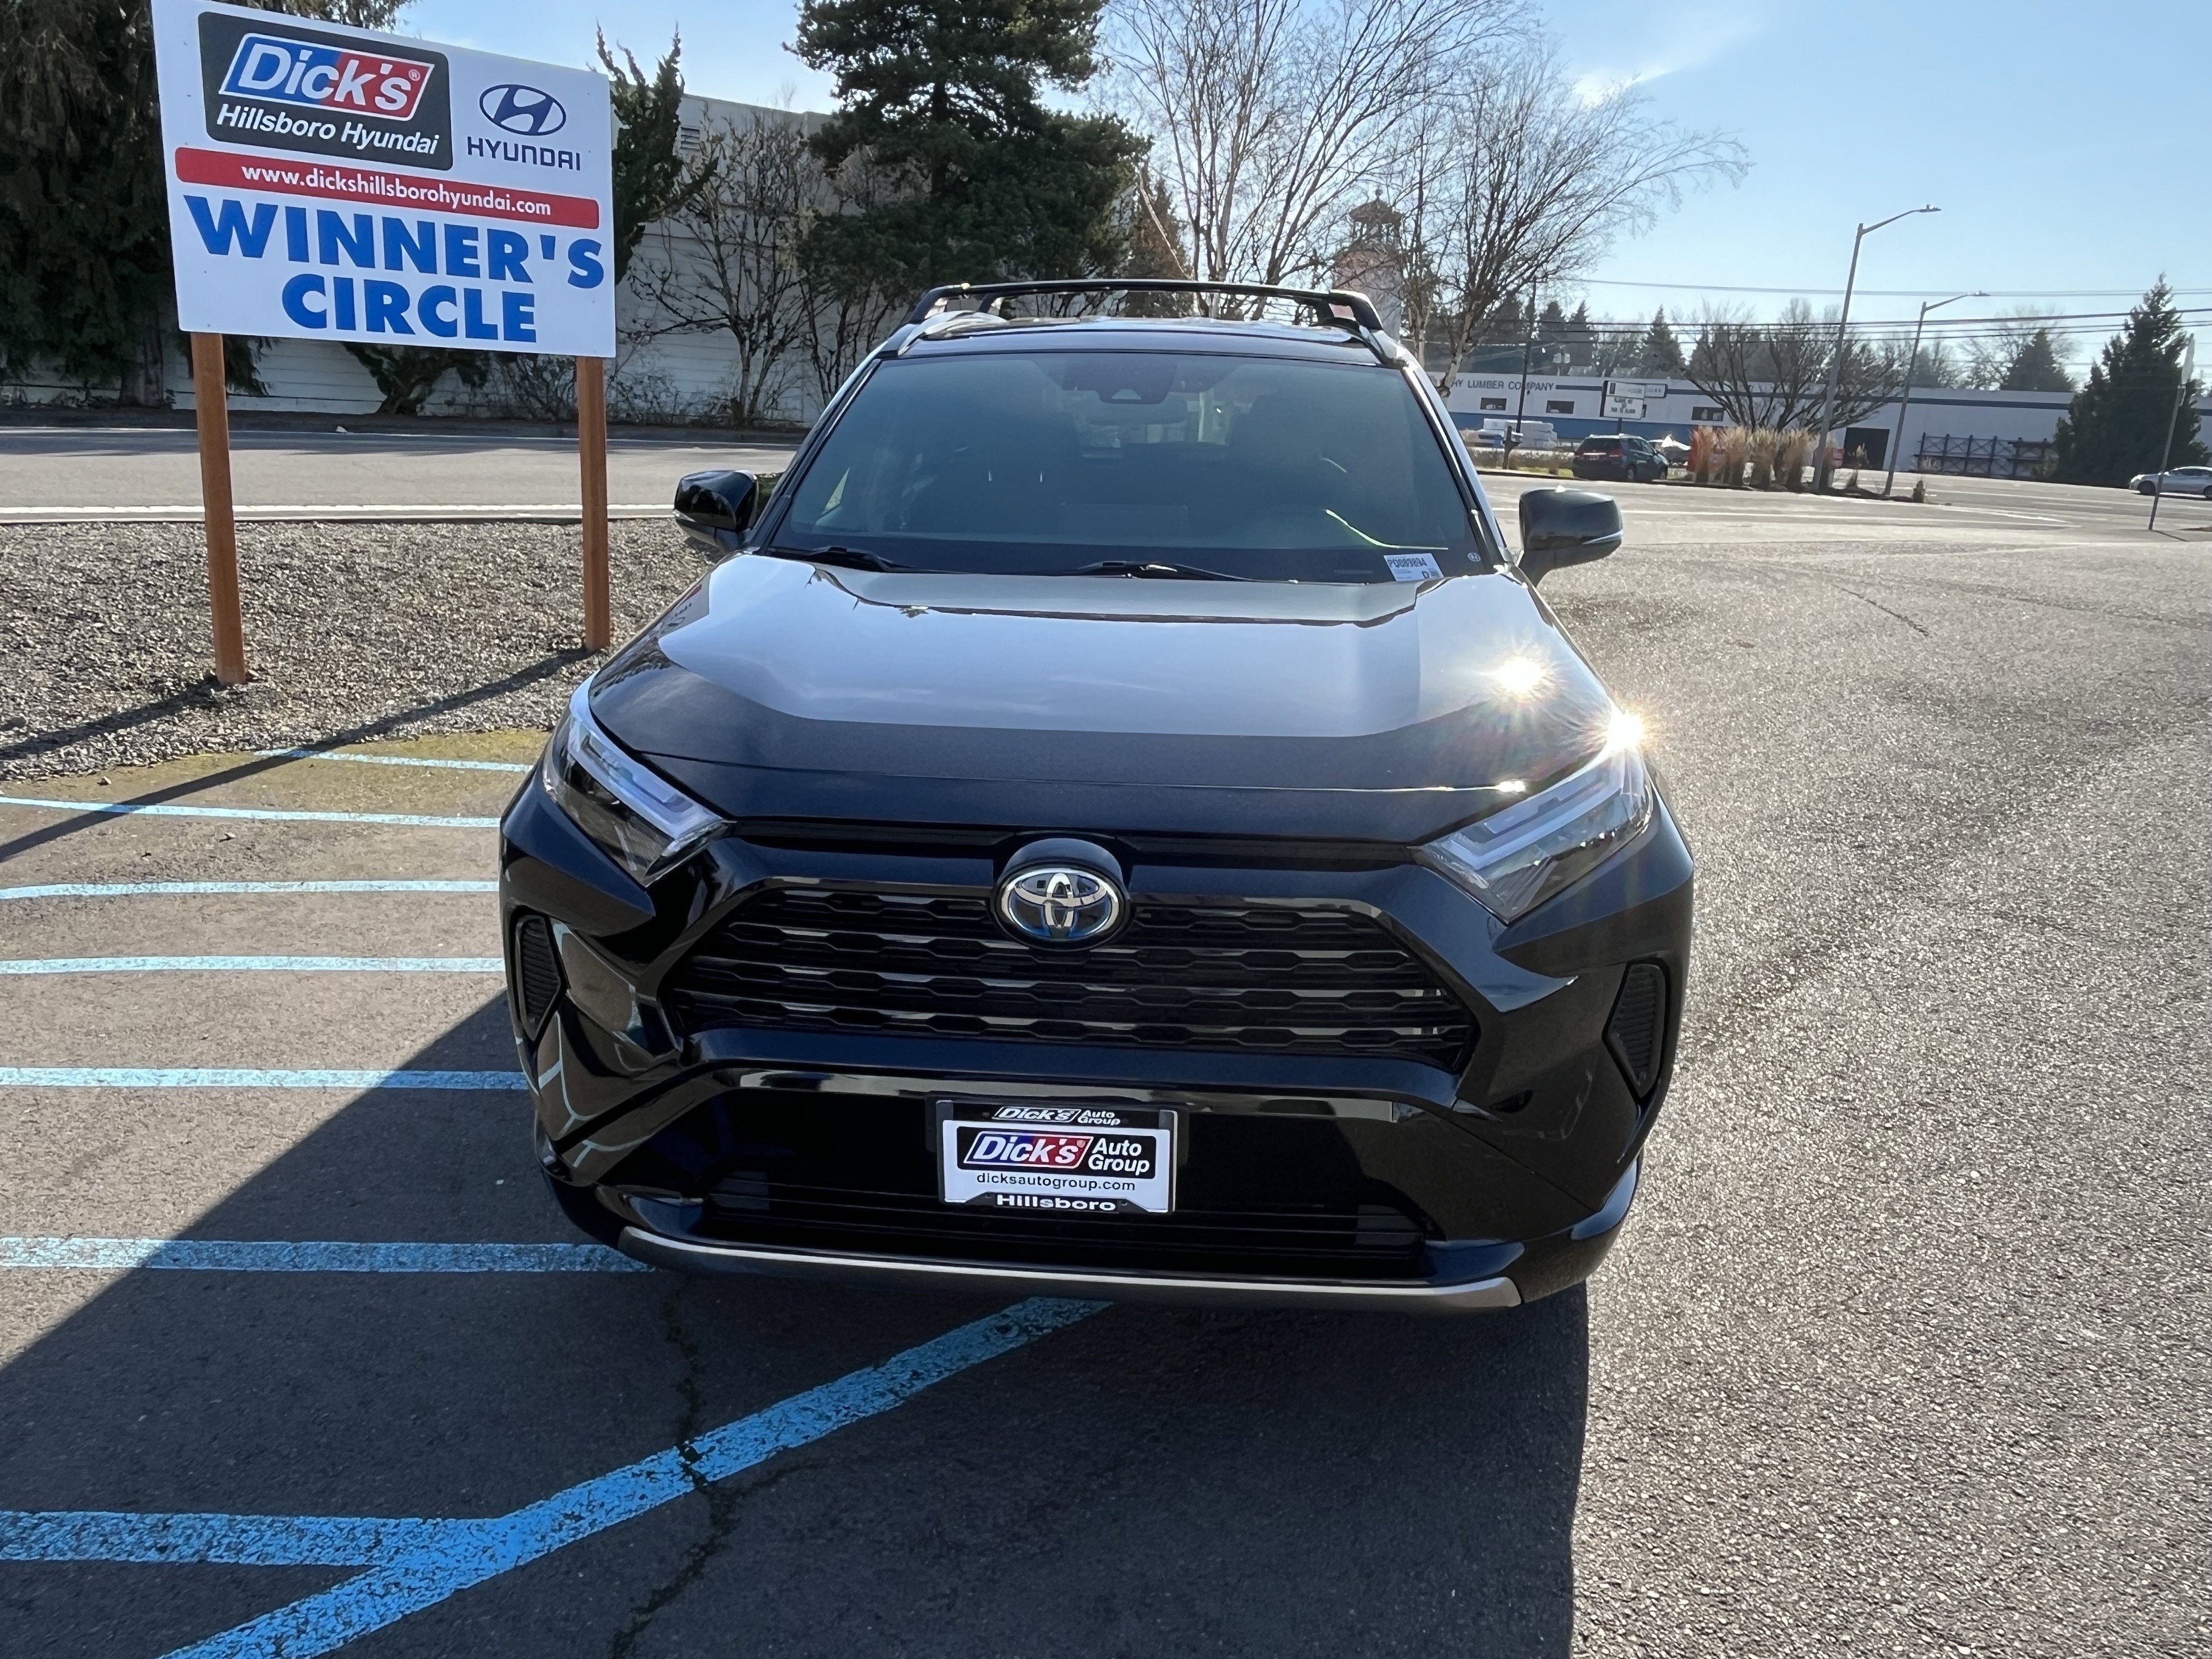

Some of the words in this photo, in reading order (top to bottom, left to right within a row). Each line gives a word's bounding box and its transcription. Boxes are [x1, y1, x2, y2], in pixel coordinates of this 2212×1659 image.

[217, 104, 335, 140] Hillsboro
[341, 122, 439, 154] Hyundai
[467, 137, 580, 171] HYUNDAI
[241, 163, 551, 216] www.dickshillsborohyundai.com
[183, 195, 604, 289] WINNER'S
[281, 274, 537, 342] CIRCLE
[1468, 380, 1504, 389] LUMBER
[1077, 1116, 1121, 1126] Group
[1081, 1110, 1115, 1119] Auto
[1092, 1137, 1142, 1156] Auto
[1088, 1154, 1150, 1176] Group
[977, 1172, 1135, 1190] dicksautogroup.com
[997, 1194, 1116, 1211] Hillsboro
